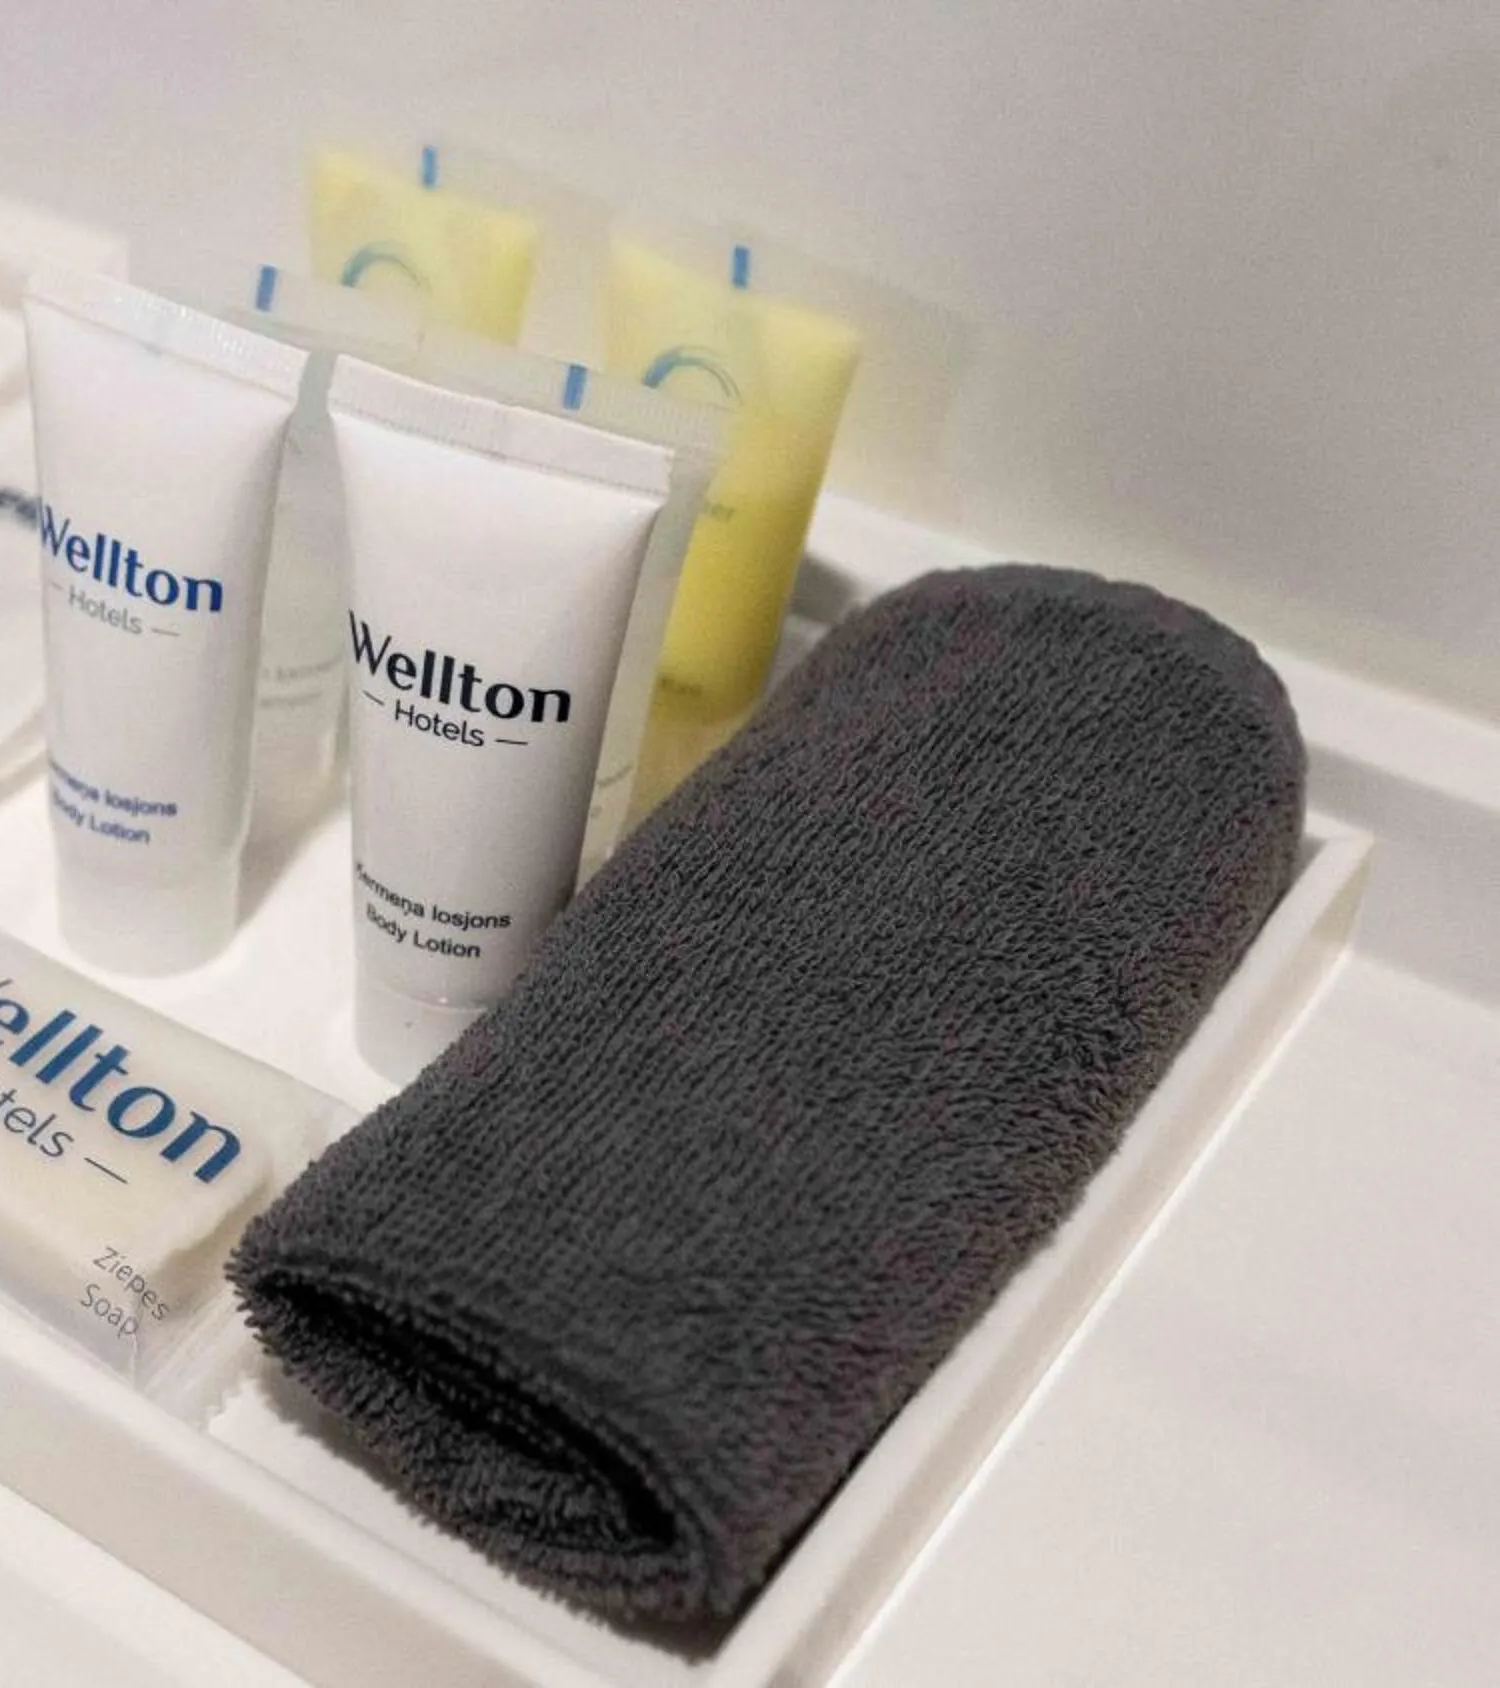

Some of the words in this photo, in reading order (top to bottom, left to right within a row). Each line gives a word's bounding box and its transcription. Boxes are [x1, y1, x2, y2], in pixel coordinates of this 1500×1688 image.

[38, 498, 224, 614] Wellton
[68, 585, 144, 637] Hotels
[349, 608, 571, 723] Wellton
[394, 700, 484, 747] Hotels
[89, 815, 151, 844] Lotion
[366, 902, 407, 943] Body
[414, 931, 481, 957] Lotion
[432, 904, 511, 931] losjons
[92, 1246, 171, 1321] Ziepes
[80, 1283, 139, 1340] Soap
